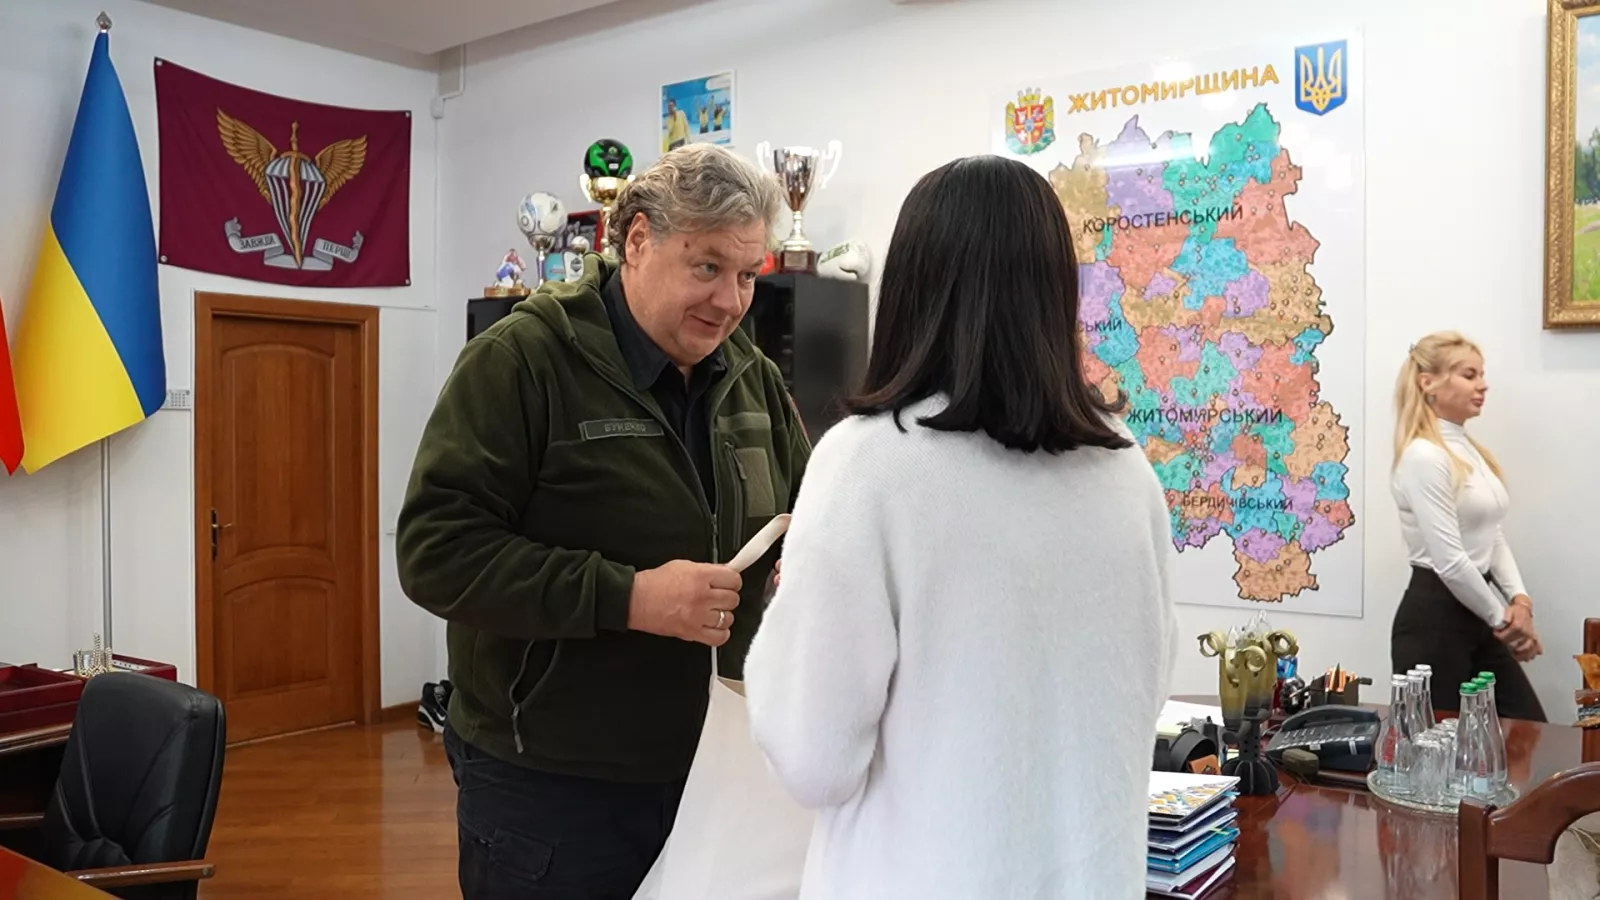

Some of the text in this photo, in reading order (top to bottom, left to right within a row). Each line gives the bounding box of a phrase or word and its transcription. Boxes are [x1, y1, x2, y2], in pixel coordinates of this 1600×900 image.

[1067, 64, 1280, 114] ЖИТОМИРЩИНА
[1082, 203, 1243, 234] КОРОСТЕНСЬКИЙ
[1078, 317, 1122, 332] СЬКИЙ
[1127, 405, 1283, 424] ЖИТОМИРСЬКИЙ
[1182, 496, 1293, 511] БЕРДИЧІВСЬКИЙ
